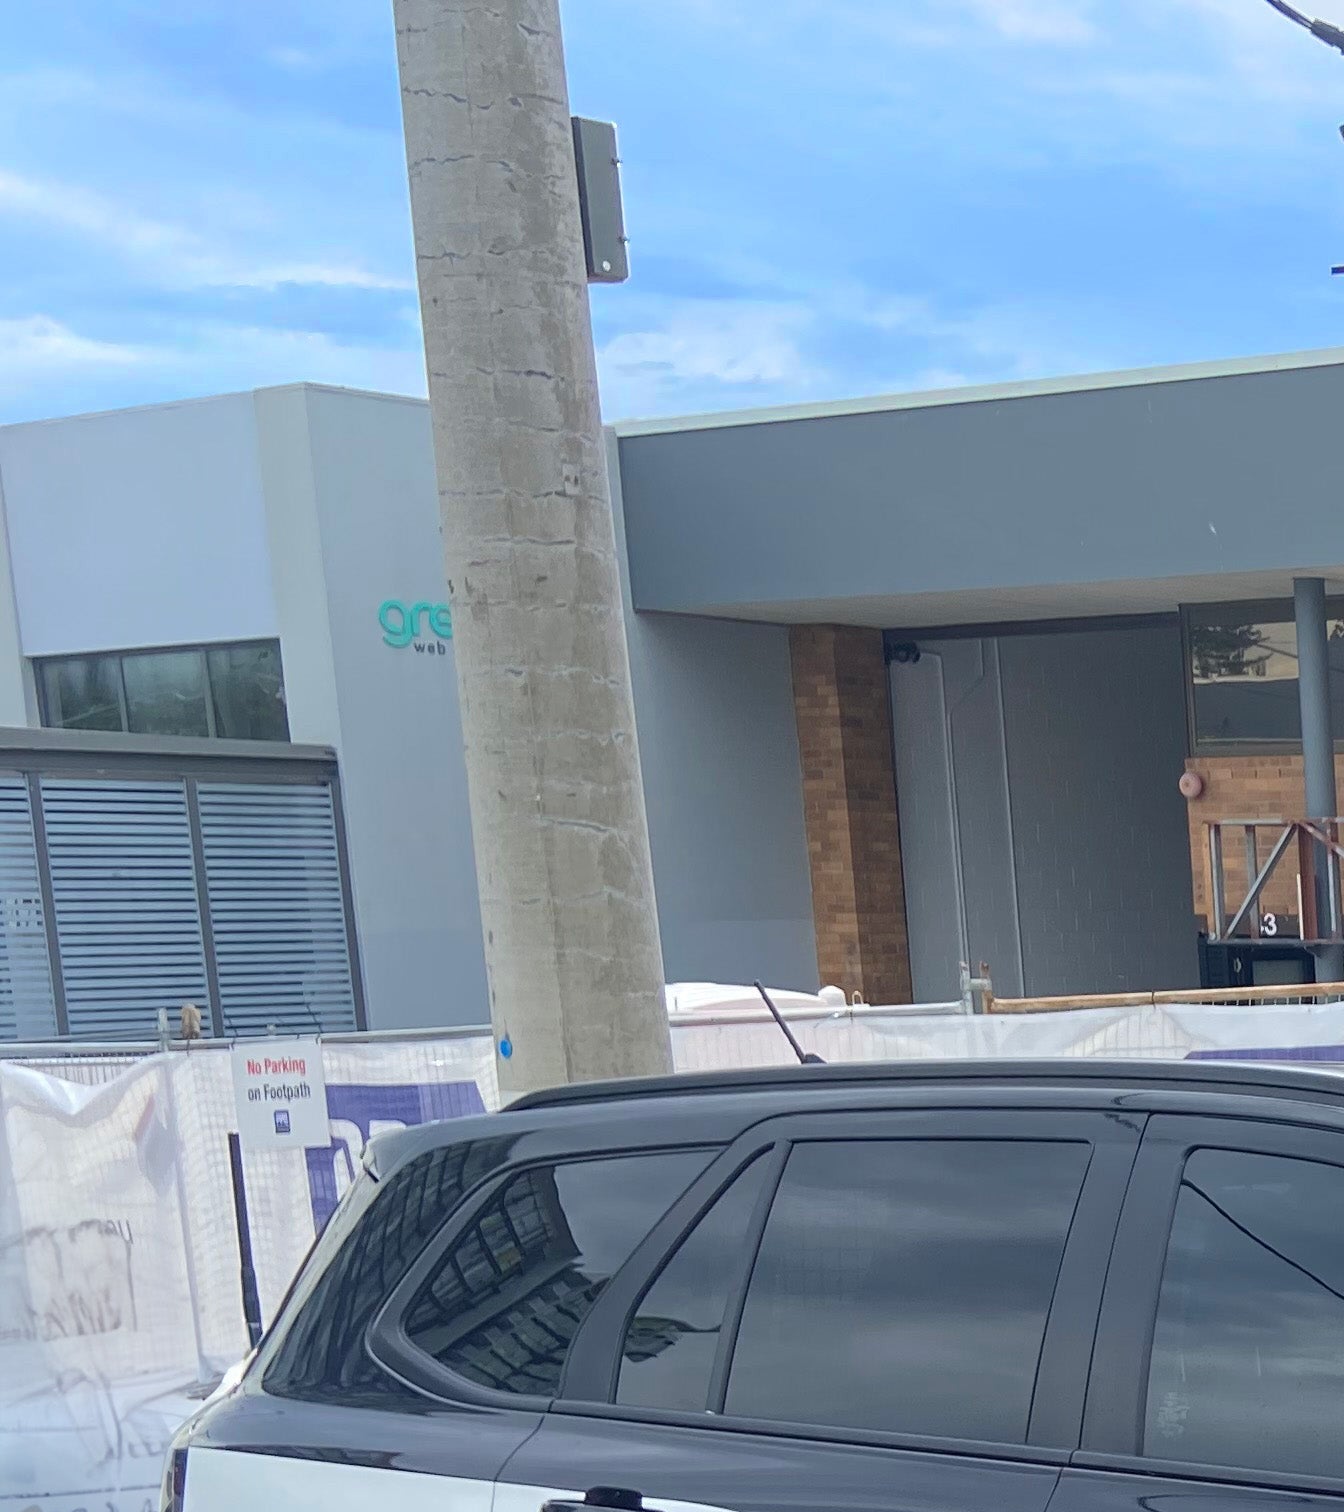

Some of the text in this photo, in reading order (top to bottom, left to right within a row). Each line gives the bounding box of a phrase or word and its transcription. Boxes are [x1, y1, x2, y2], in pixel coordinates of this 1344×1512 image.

[414, 641, 446, 656] web
[247, 1057, 306, 1076] No Parking
[247, 1081, 311, 1102] on Footpath
